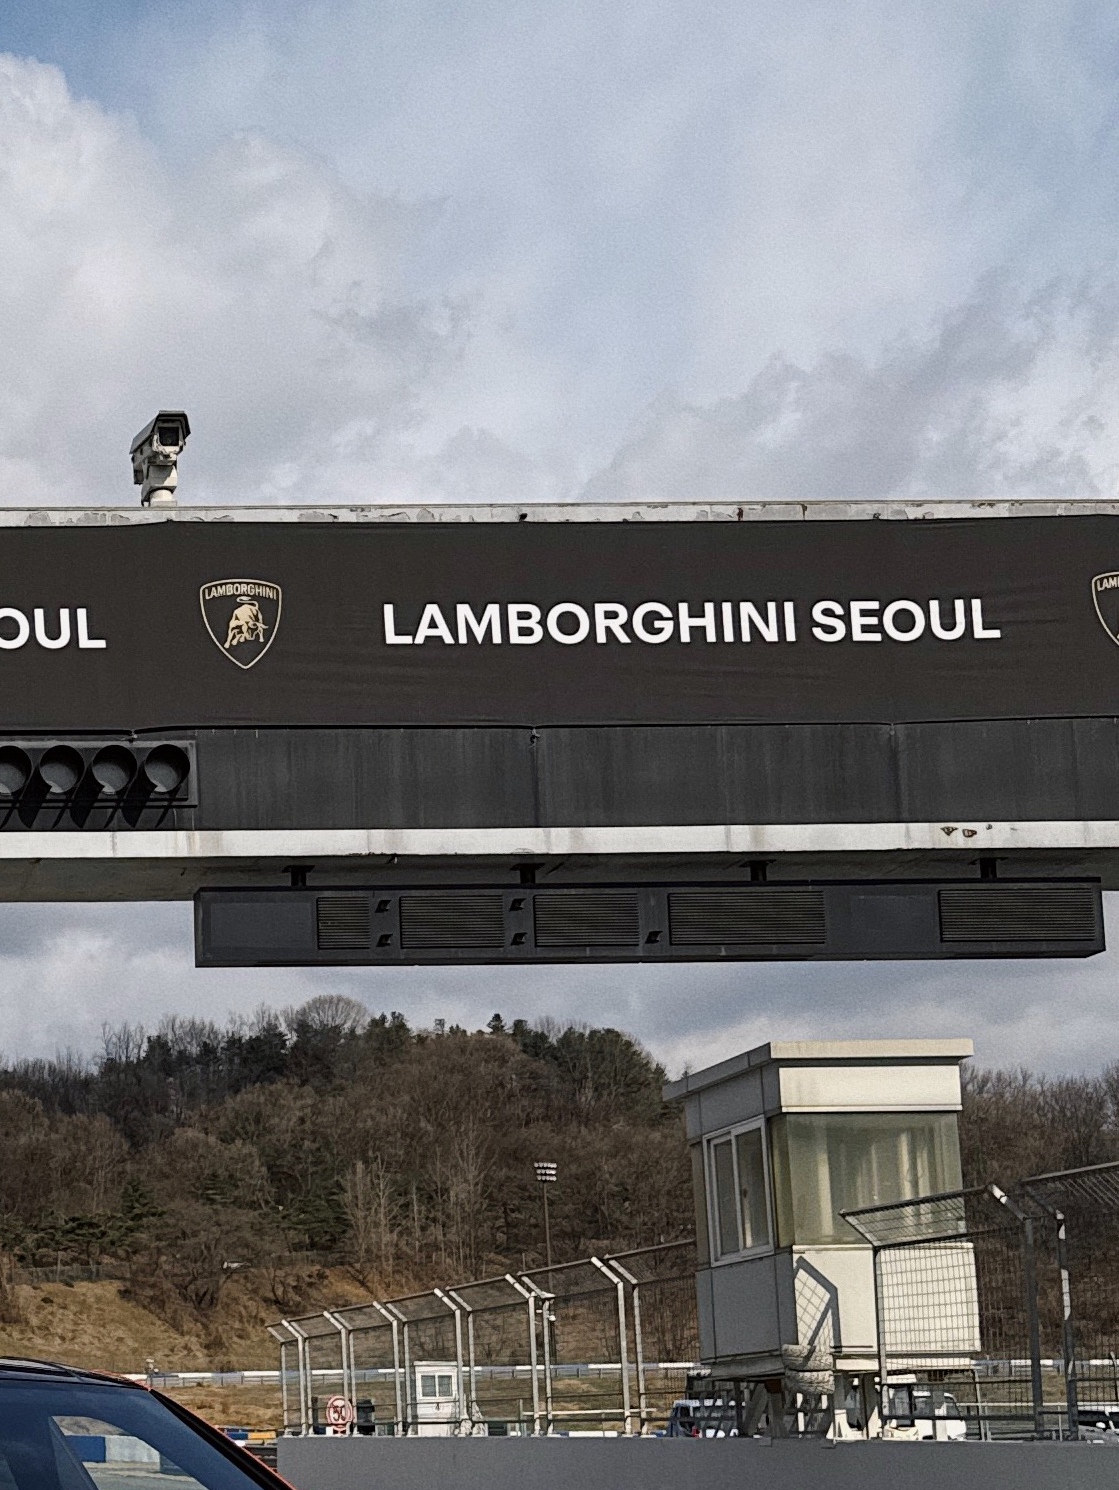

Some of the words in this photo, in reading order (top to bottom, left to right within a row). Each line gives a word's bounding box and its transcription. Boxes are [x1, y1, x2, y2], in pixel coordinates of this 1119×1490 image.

[205, 583, 278, 601] LAMBORGHINI
[383, 601, 797, 645] LAMBORGHINI
[811, 598, 1002, 642] SEOUL
